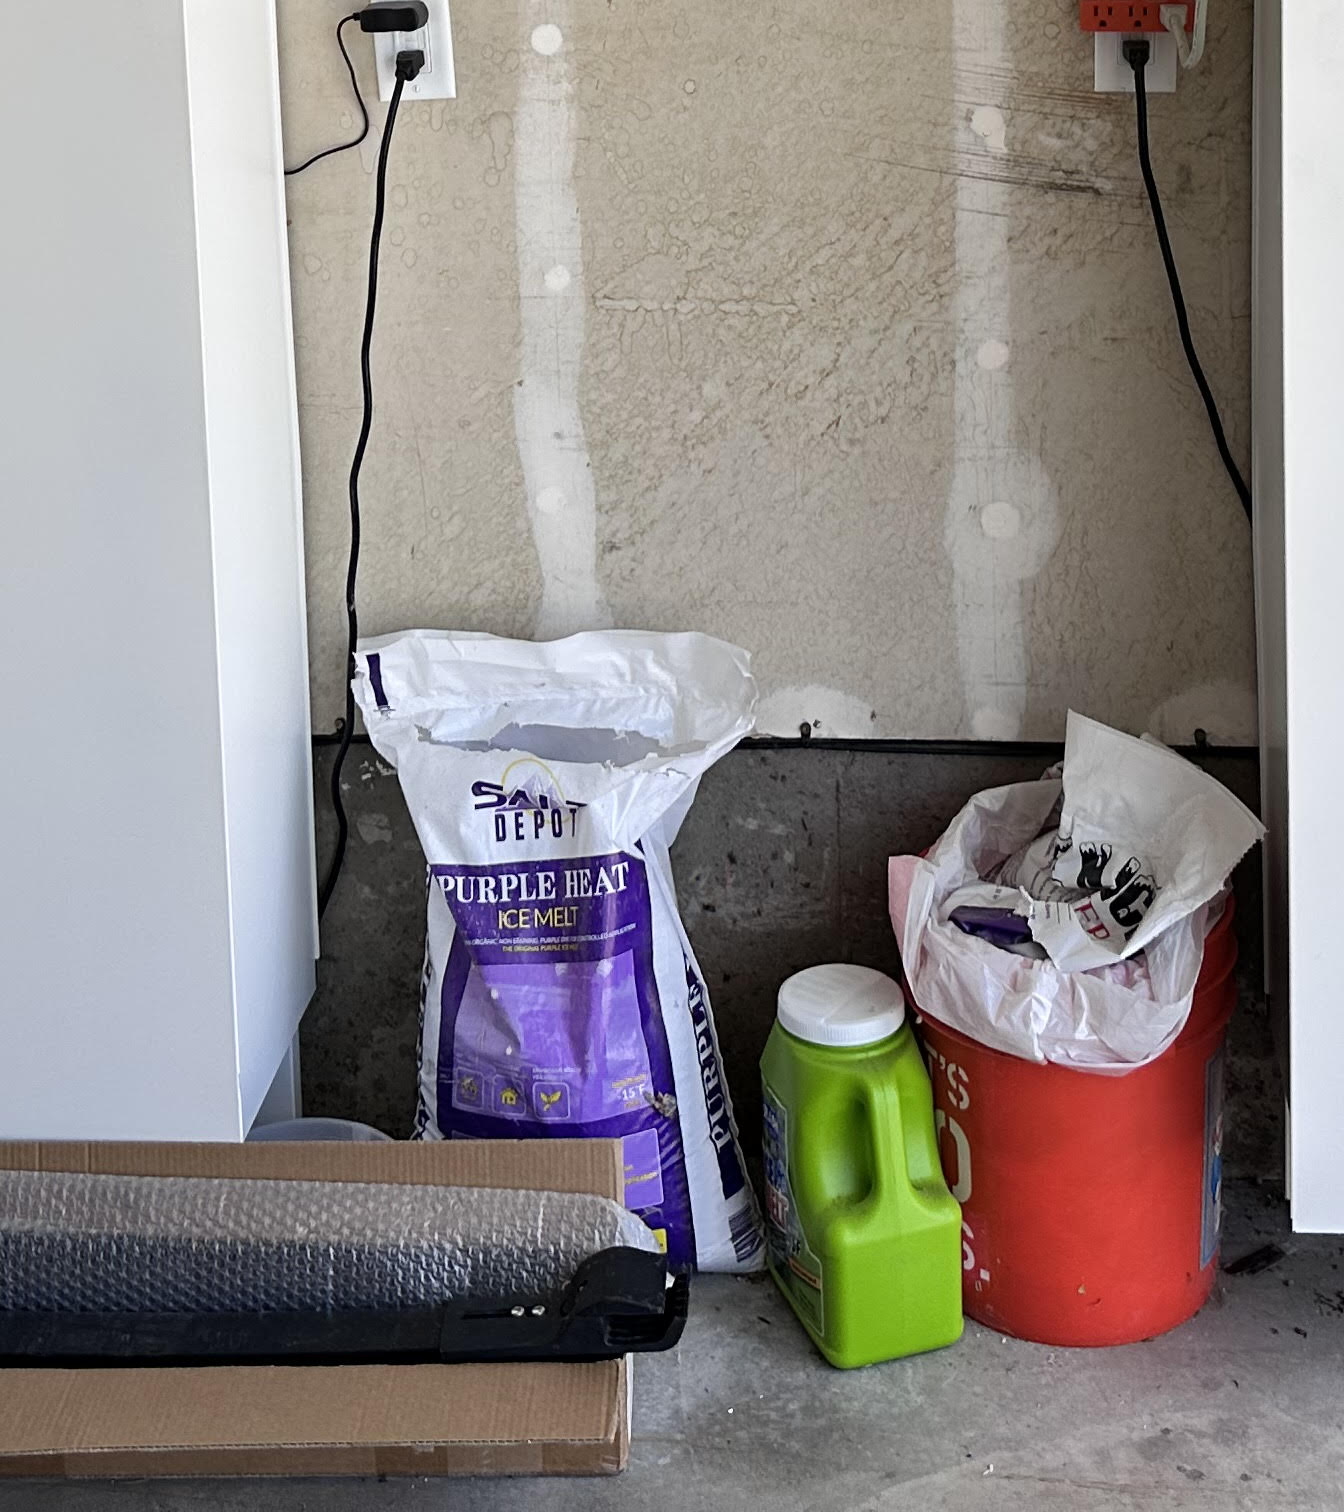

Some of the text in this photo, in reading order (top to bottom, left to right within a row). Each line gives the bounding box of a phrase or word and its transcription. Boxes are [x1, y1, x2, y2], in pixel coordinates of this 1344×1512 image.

[494, 808, 578, 841] DEPOT
[437, 861, 630, 904] PURPLE HEAT
[498, 906, 579, 930] ICE MELT
